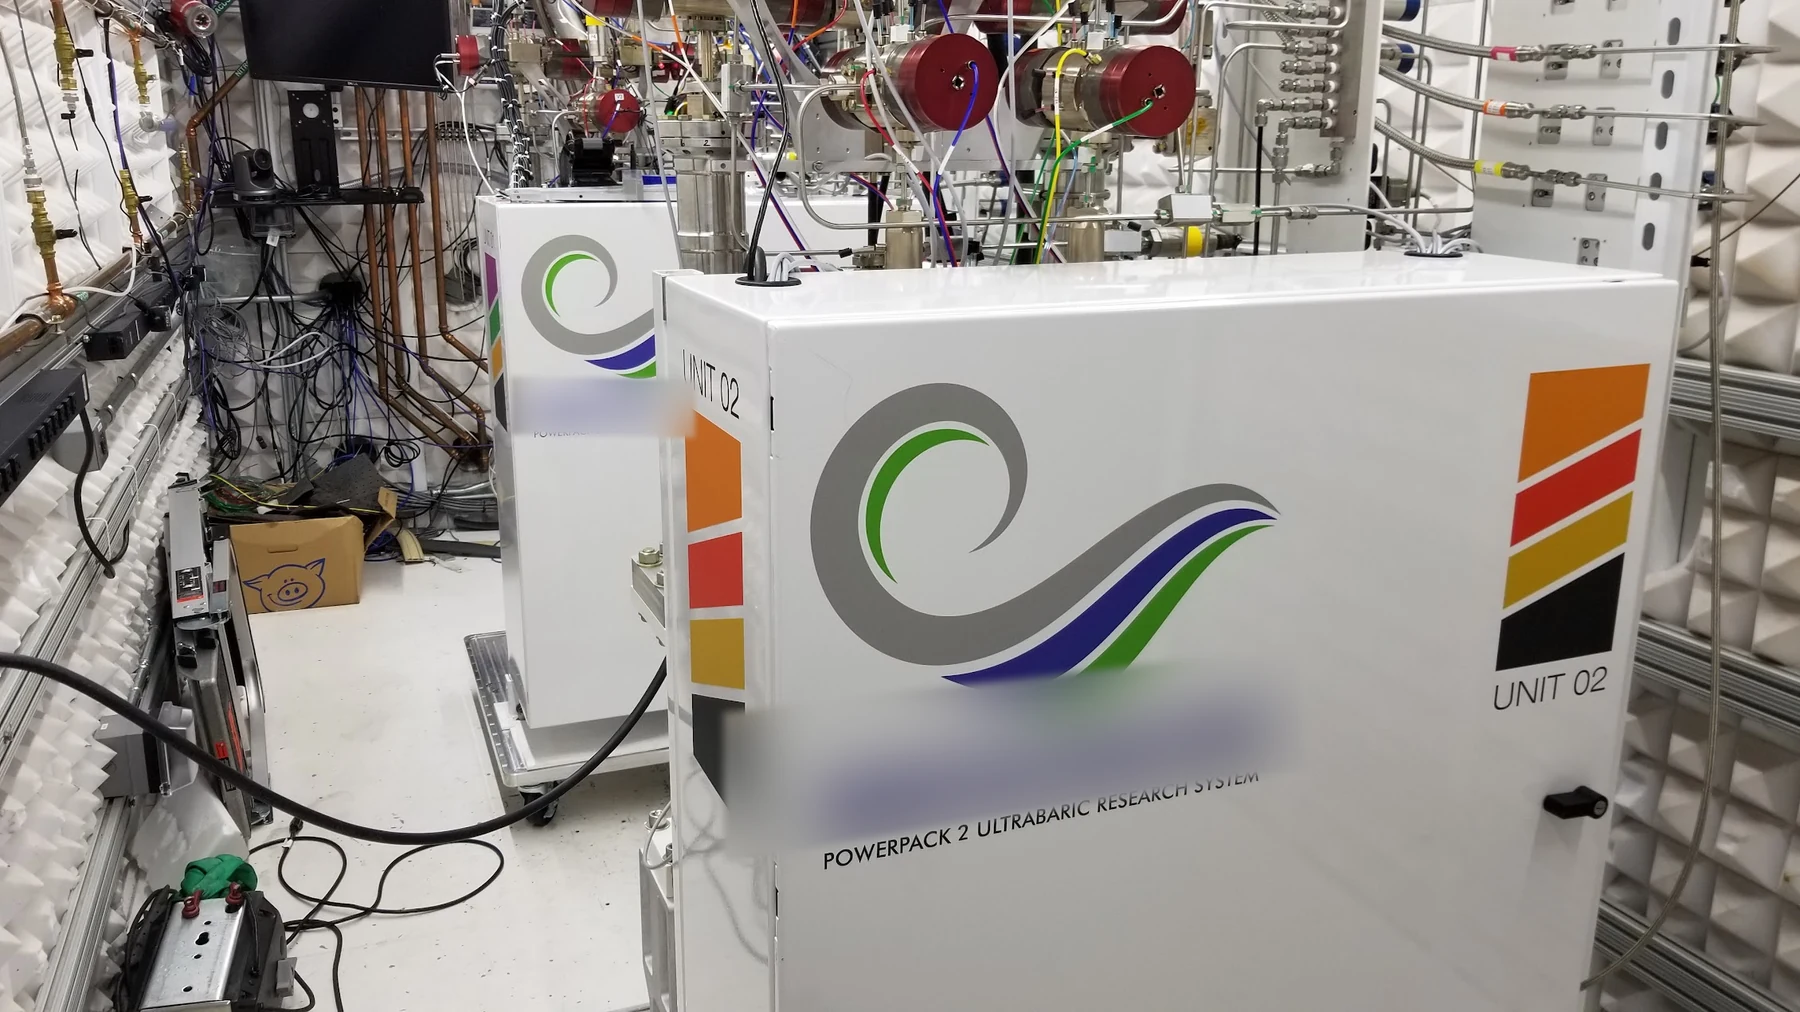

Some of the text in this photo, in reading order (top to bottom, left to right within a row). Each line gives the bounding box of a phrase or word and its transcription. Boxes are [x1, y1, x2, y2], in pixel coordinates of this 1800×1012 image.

[235, 61, 249, 77] NITR
[720, 372, 740, 419] 02
[1493, 666, 1608, 711] UNIT 02
[823, 828, 952, 870] POWERPACK
[957, 824, 970, 842] 2
[977, 799, 1090, 838] ULTRABARIC
[1097, 781, 1188, 813] RESEARCH
